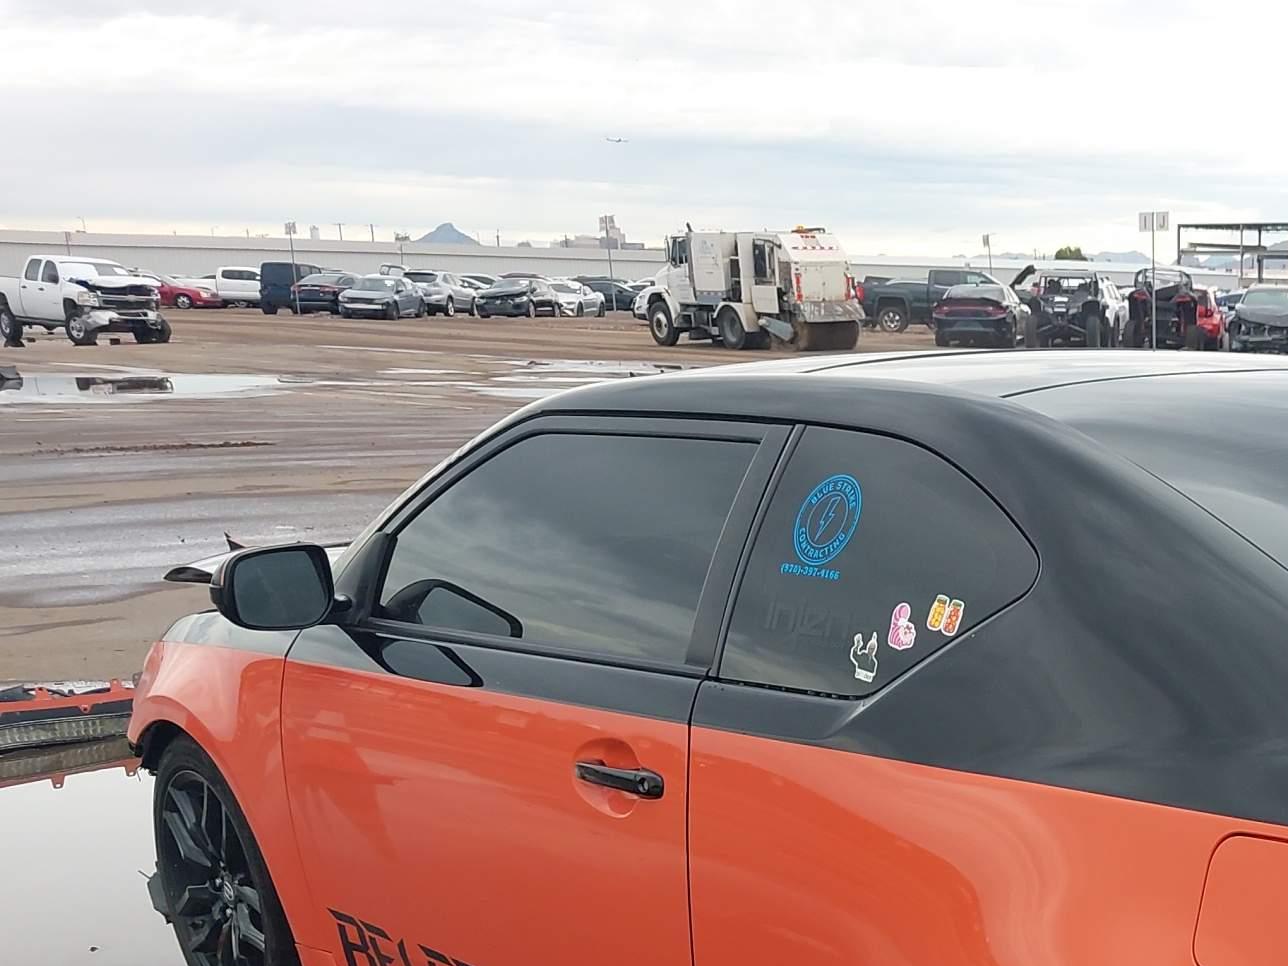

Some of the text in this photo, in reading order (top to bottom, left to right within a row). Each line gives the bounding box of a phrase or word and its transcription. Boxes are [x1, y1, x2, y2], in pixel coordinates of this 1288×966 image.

[809, 481, 857, 510] BLUE STRIKE
[798, 527, 846, 559] CONTRACTING
